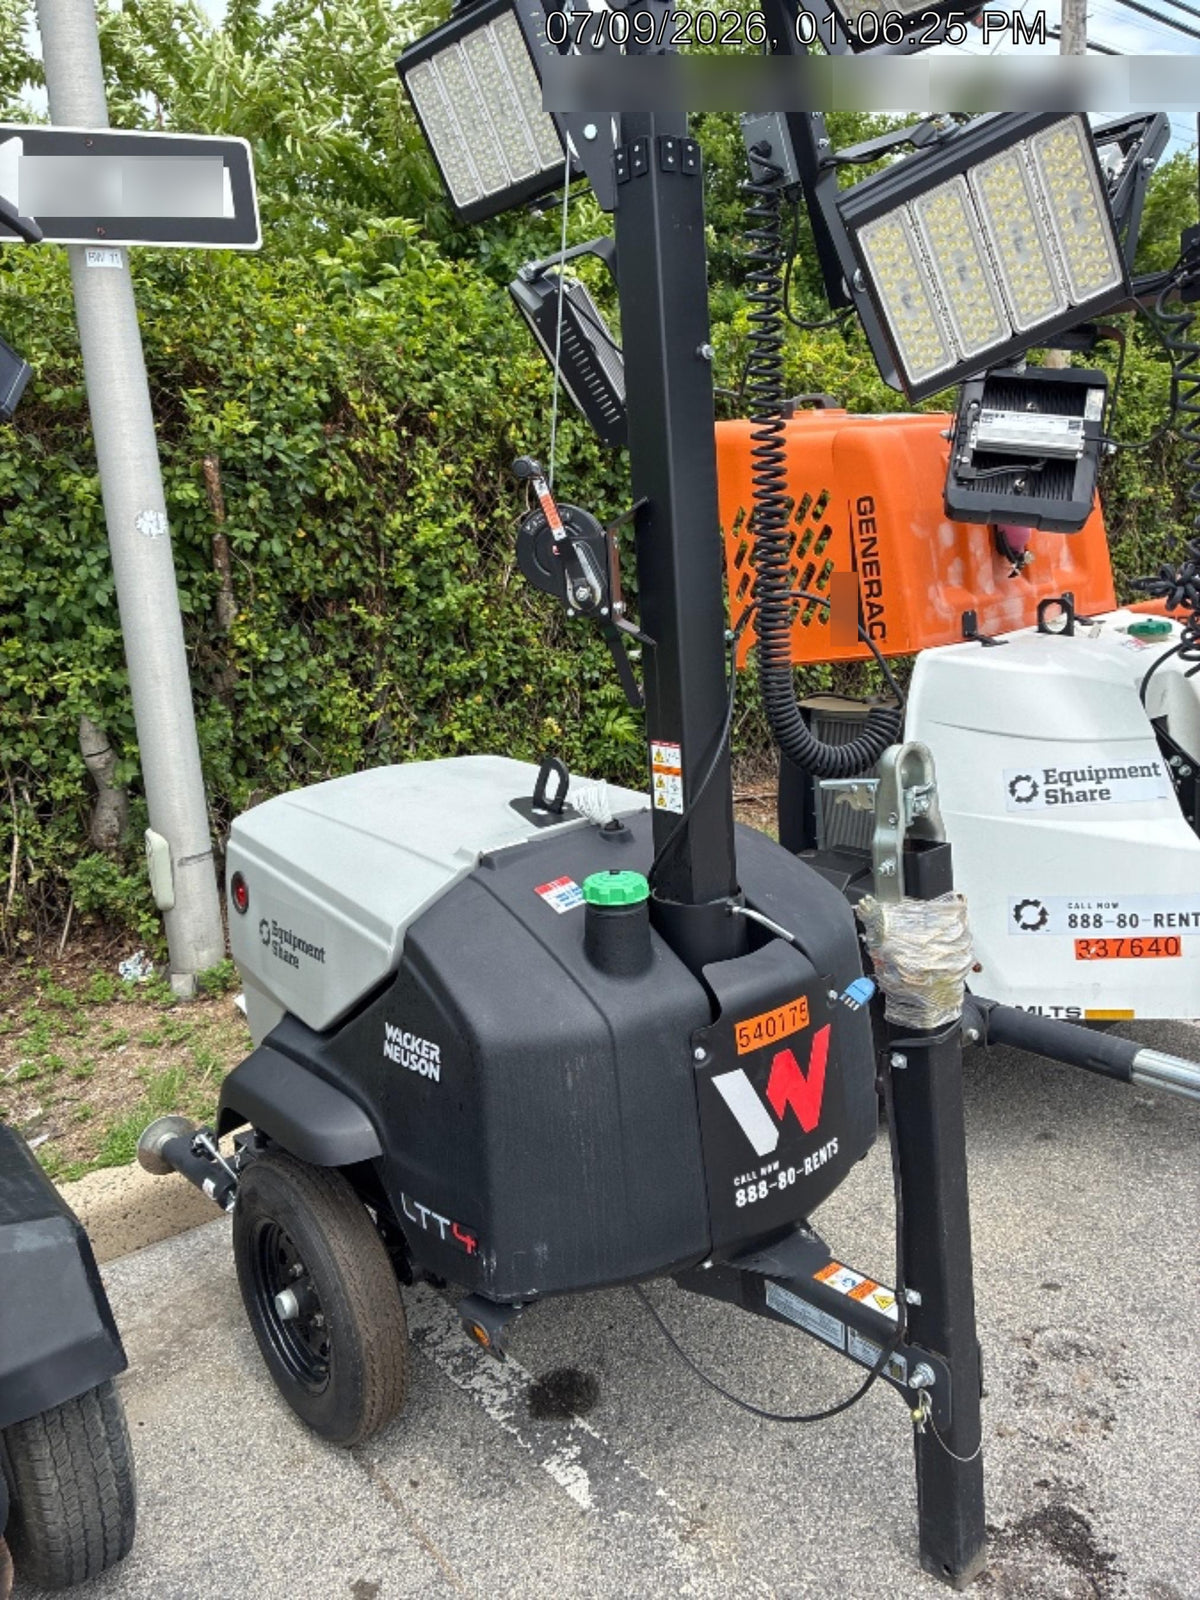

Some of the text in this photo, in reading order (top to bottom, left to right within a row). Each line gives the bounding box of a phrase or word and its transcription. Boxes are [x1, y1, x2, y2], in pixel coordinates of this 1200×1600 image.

[856, 496, 886, 641] GENERAC
[1043, 762, 1162, 786] Equipment
[1044, 788, 1112, 805] Share
[1068, 902, 1119, 910] CALL NOW
[271, 918, 326, 964] Equipment
[271, 939, 300, 970] Share
[1078, 936, 1180, 960] 337640
[384, 1021, 441, 1064] WACKER
[738, 1001, 808, 1049] 540175
[383, 1039, 441, 1083] NEUSON
[733, 1160, 780, 1187] CALL NOW
[735, 1137, 839, 1208] 888-80-RENTS
[400, 1192, 476, 1254] LTT4
